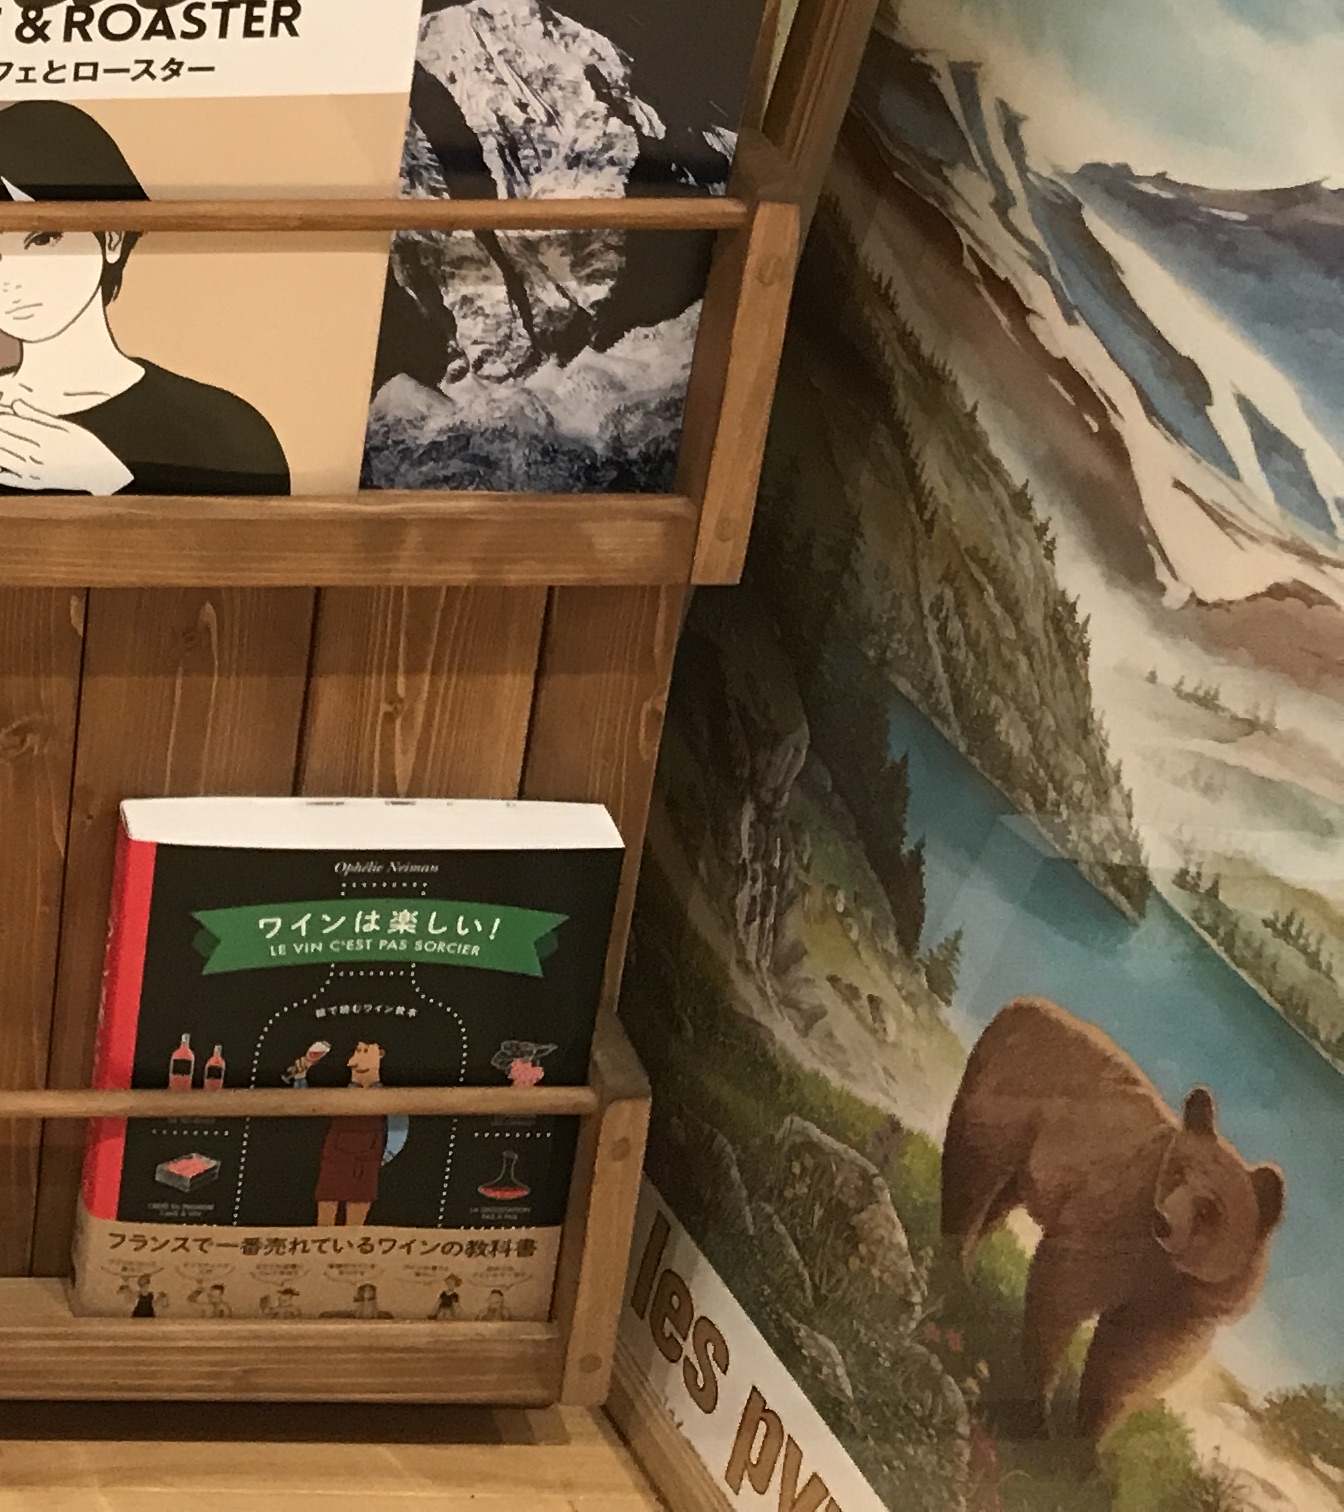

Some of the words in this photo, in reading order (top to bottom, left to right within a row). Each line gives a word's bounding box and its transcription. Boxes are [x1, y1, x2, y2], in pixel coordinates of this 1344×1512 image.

[14, 5, 52, 45] &
[63, 0, 302, 44] ROASTER
[258, 908, 501, 941] ワインは楽しい!
[270, 943, 287, 956] LE
[293, 941, 323, 954] VIN
[329, 938, 373, 952] C'EST
[378, 939, 407, 951] PAS
[414, 939, 481, 957] SORCIER
[108, 1232, 538, 1258] フランスで一番売れているワインの教科書
[629, 1209, 730, 1414] les
[724, 1385, 842, 1512] py
